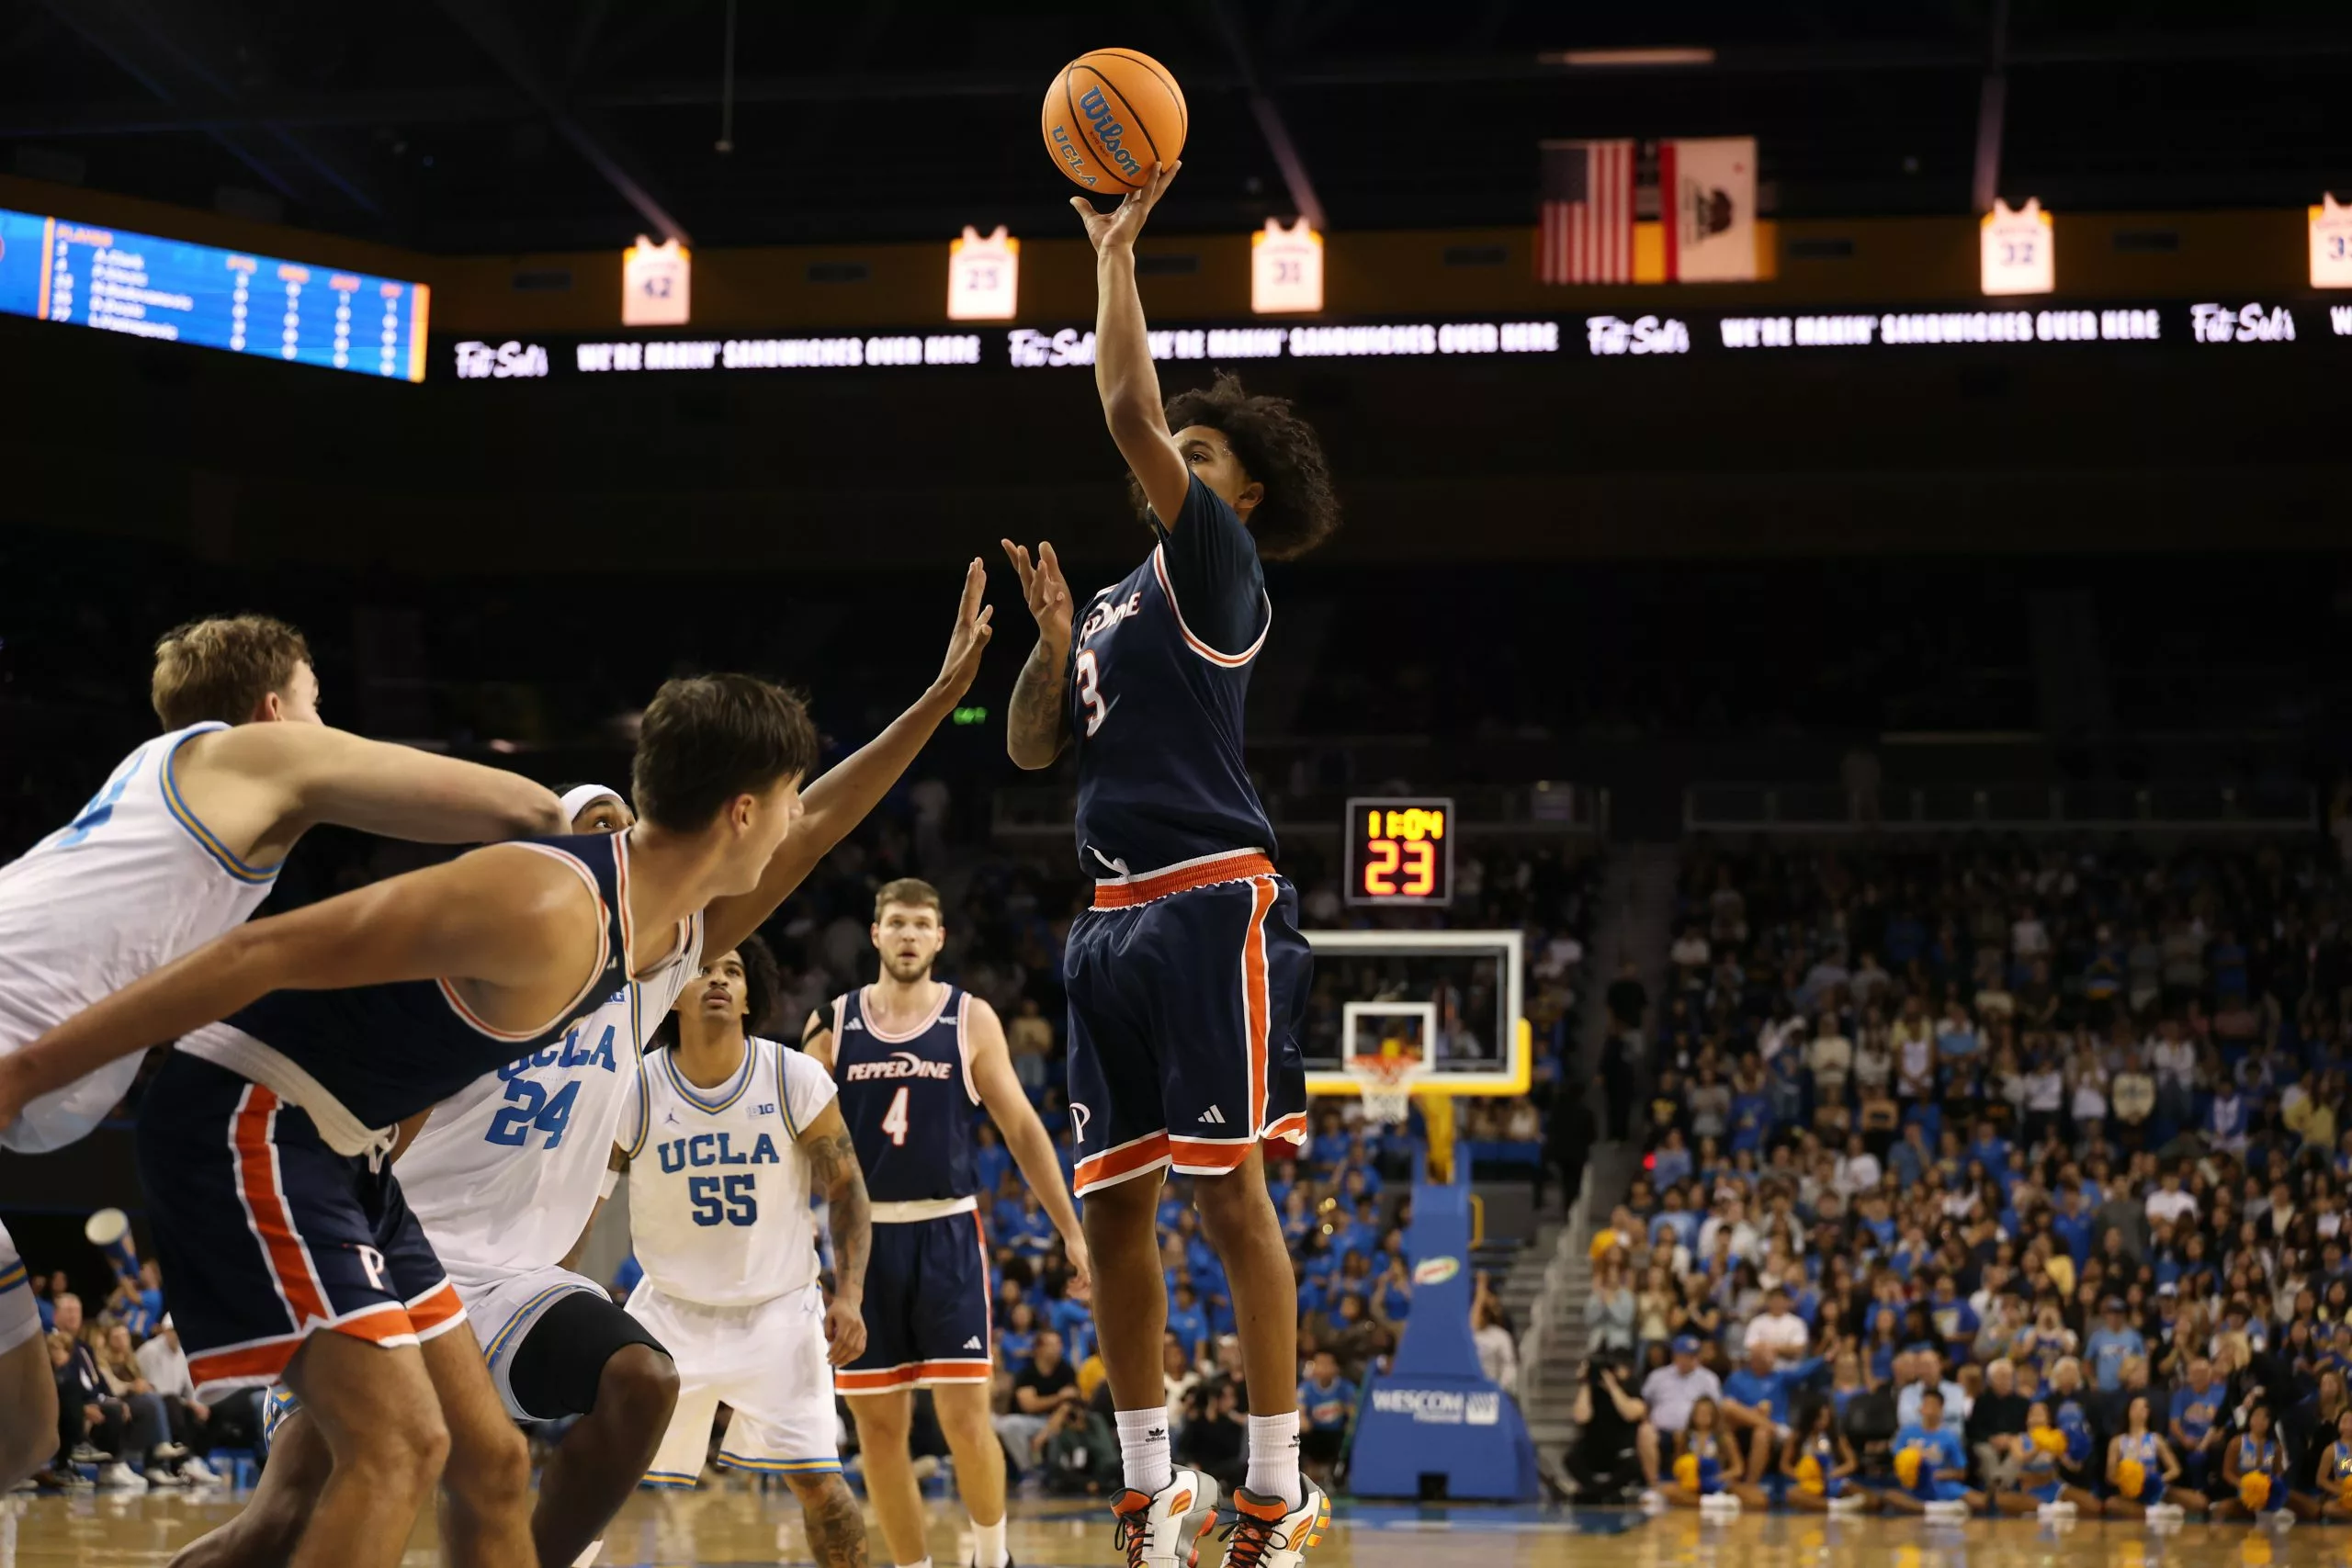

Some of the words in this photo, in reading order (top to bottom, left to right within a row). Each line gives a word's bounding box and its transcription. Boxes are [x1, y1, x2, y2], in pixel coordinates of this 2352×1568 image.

[1052, 125, 1098, 186] UCLA
[1080, 85, 1141, 177] Wilson
[1077, 649, 1107, 738] 3
[1368, 808, 1443, 840] 11:04
[1365, 840, 1434, 896] 23
[846, 1052, 953, 1081] PEPPERDINE
[484, 1077, 582, 1150] 24
[881, 1086, 910, 1145] 4
[658, 1133, 780, 1174] UCLA
[688, 1173, 758, 1226] 55
[1373, 1389, 1464, 1416] WESCOM
